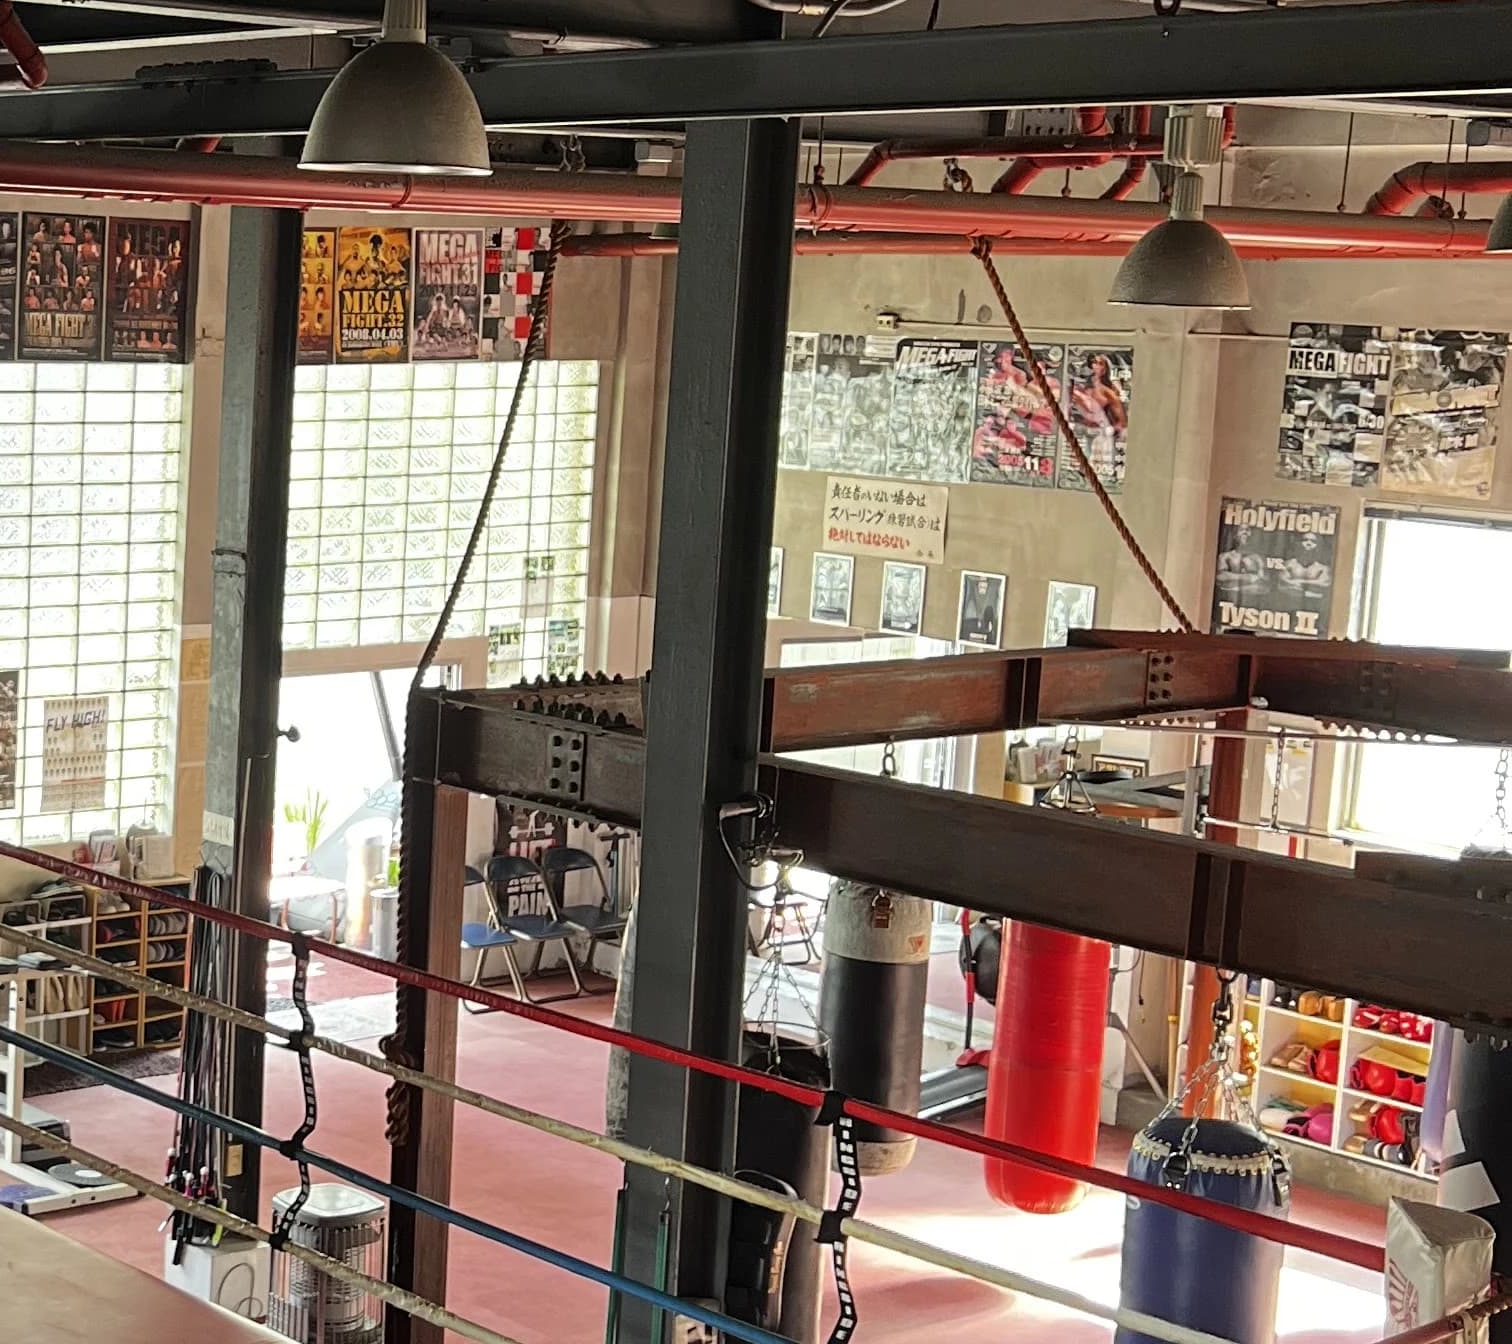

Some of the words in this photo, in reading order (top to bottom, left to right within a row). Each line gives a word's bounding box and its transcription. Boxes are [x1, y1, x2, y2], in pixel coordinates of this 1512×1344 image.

[420, 233, 478, 262] MEGA
[343, 290, 404, 313] MEGA
[24, 312, 52, 337] MEGA
[55, 313, 85, 338] FIGHT
[342, 328, 404, 340] 2008.04.03
[343, 314, 405, 328] FIGHT.32
[1289, 350, 1336, 372] MEGA
[1338, 352, 1391, 377] FIGHT
[1224, 503, 1337, 535] Holyfield
[1219, 601, 1290, 631] Tyson
[46, 716, 68, 733] FLY
[71, 710, 106, 731] HIGH!
